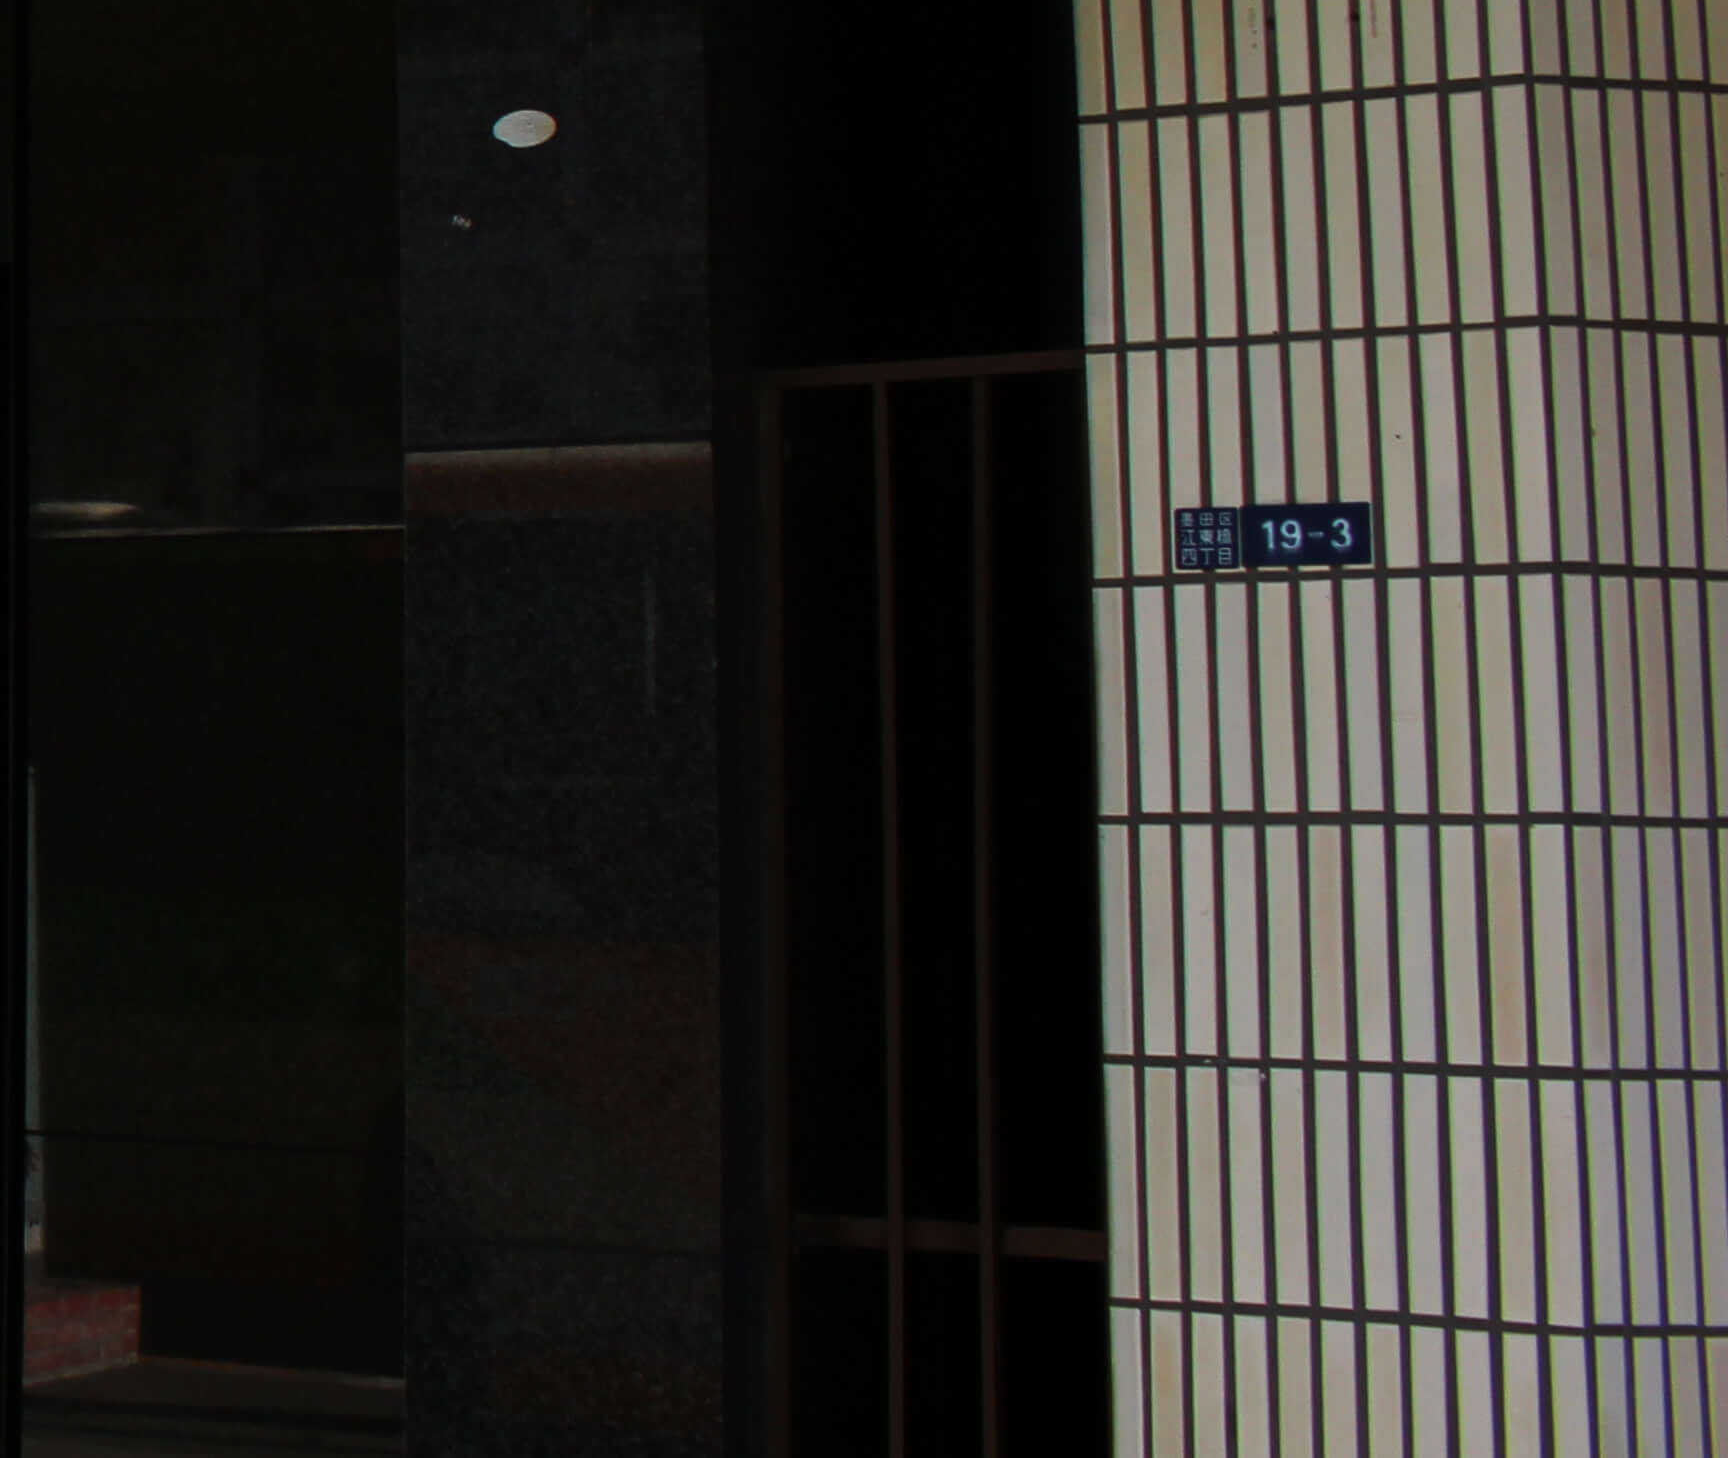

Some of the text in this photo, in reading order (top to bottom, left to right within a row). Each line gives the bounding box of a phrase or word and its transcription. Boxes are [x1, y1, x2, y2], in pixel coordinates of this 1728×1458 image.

[1261, 518, 1353, 551] 19-3
[1181, 546, 1233, 566] 四丁目
